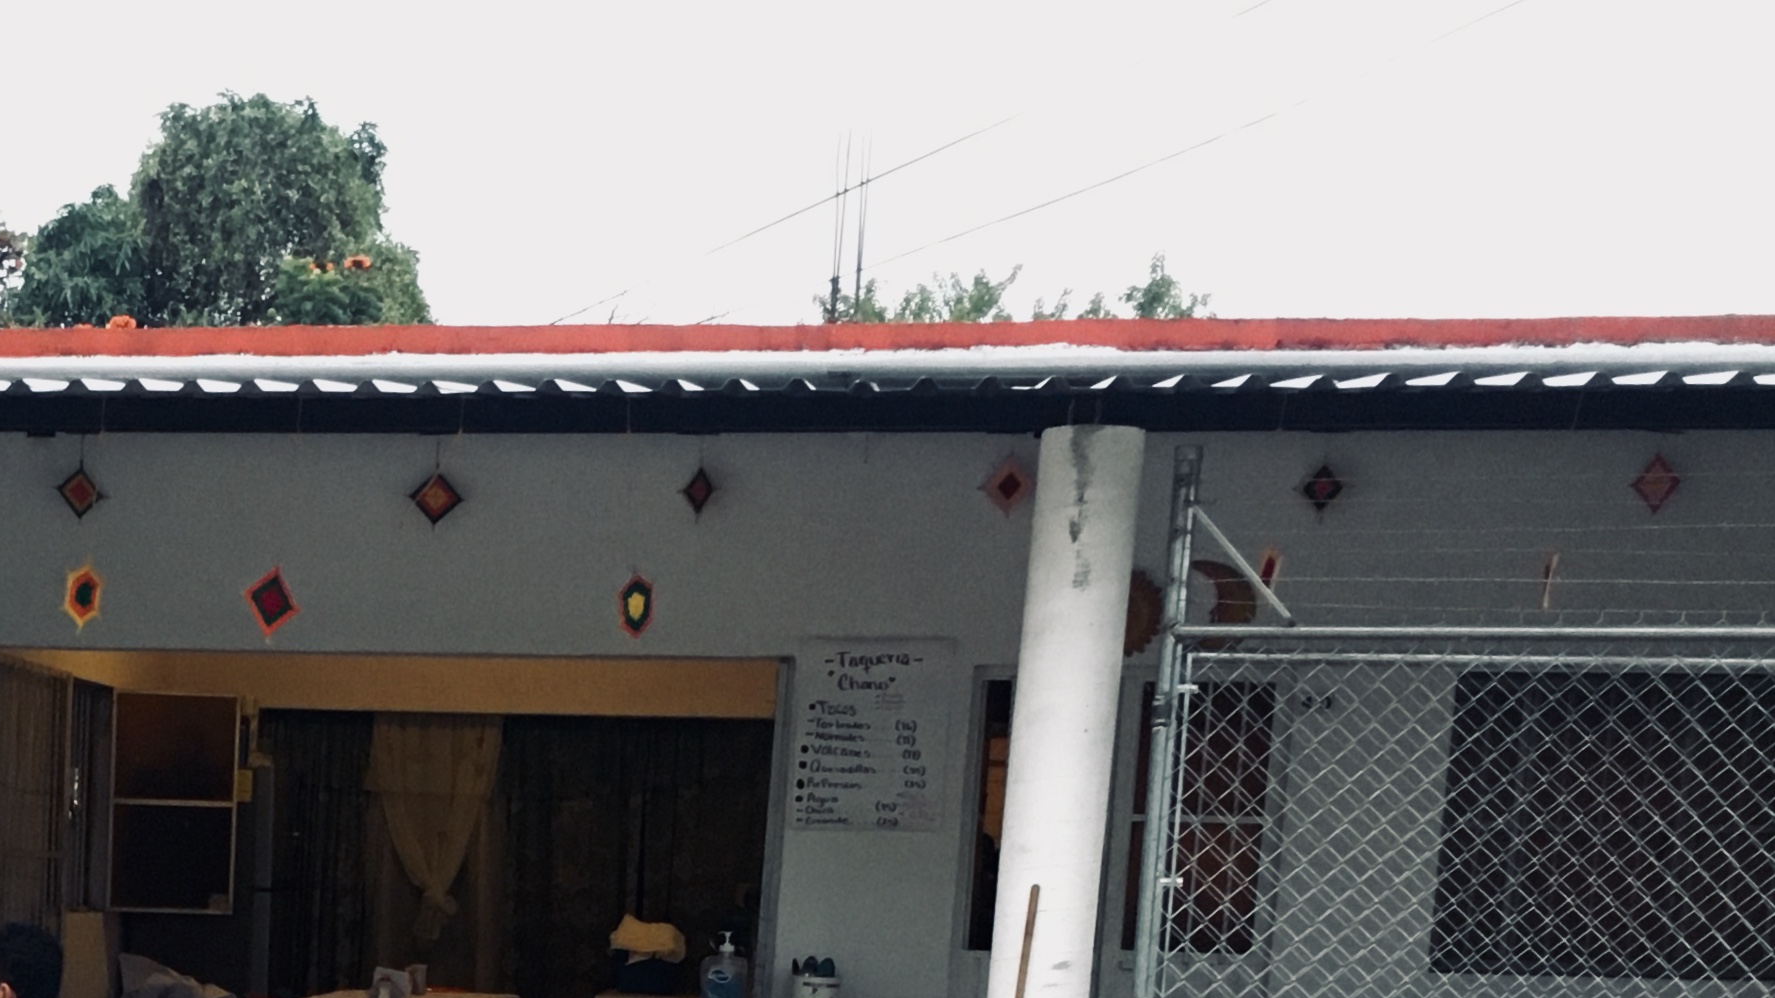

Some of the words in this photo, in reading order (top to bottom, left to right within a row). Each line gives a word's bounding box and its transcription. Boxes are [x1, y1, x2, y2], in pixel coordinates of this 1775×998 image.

[835, 651, 910, 674] Taqueria
[837, 673, 890, 691] Chano
[816, 699, 857, 717] Tacos
[810, 745, 871, 758] Volcanes
[807, 792, 839, 807] Agua
